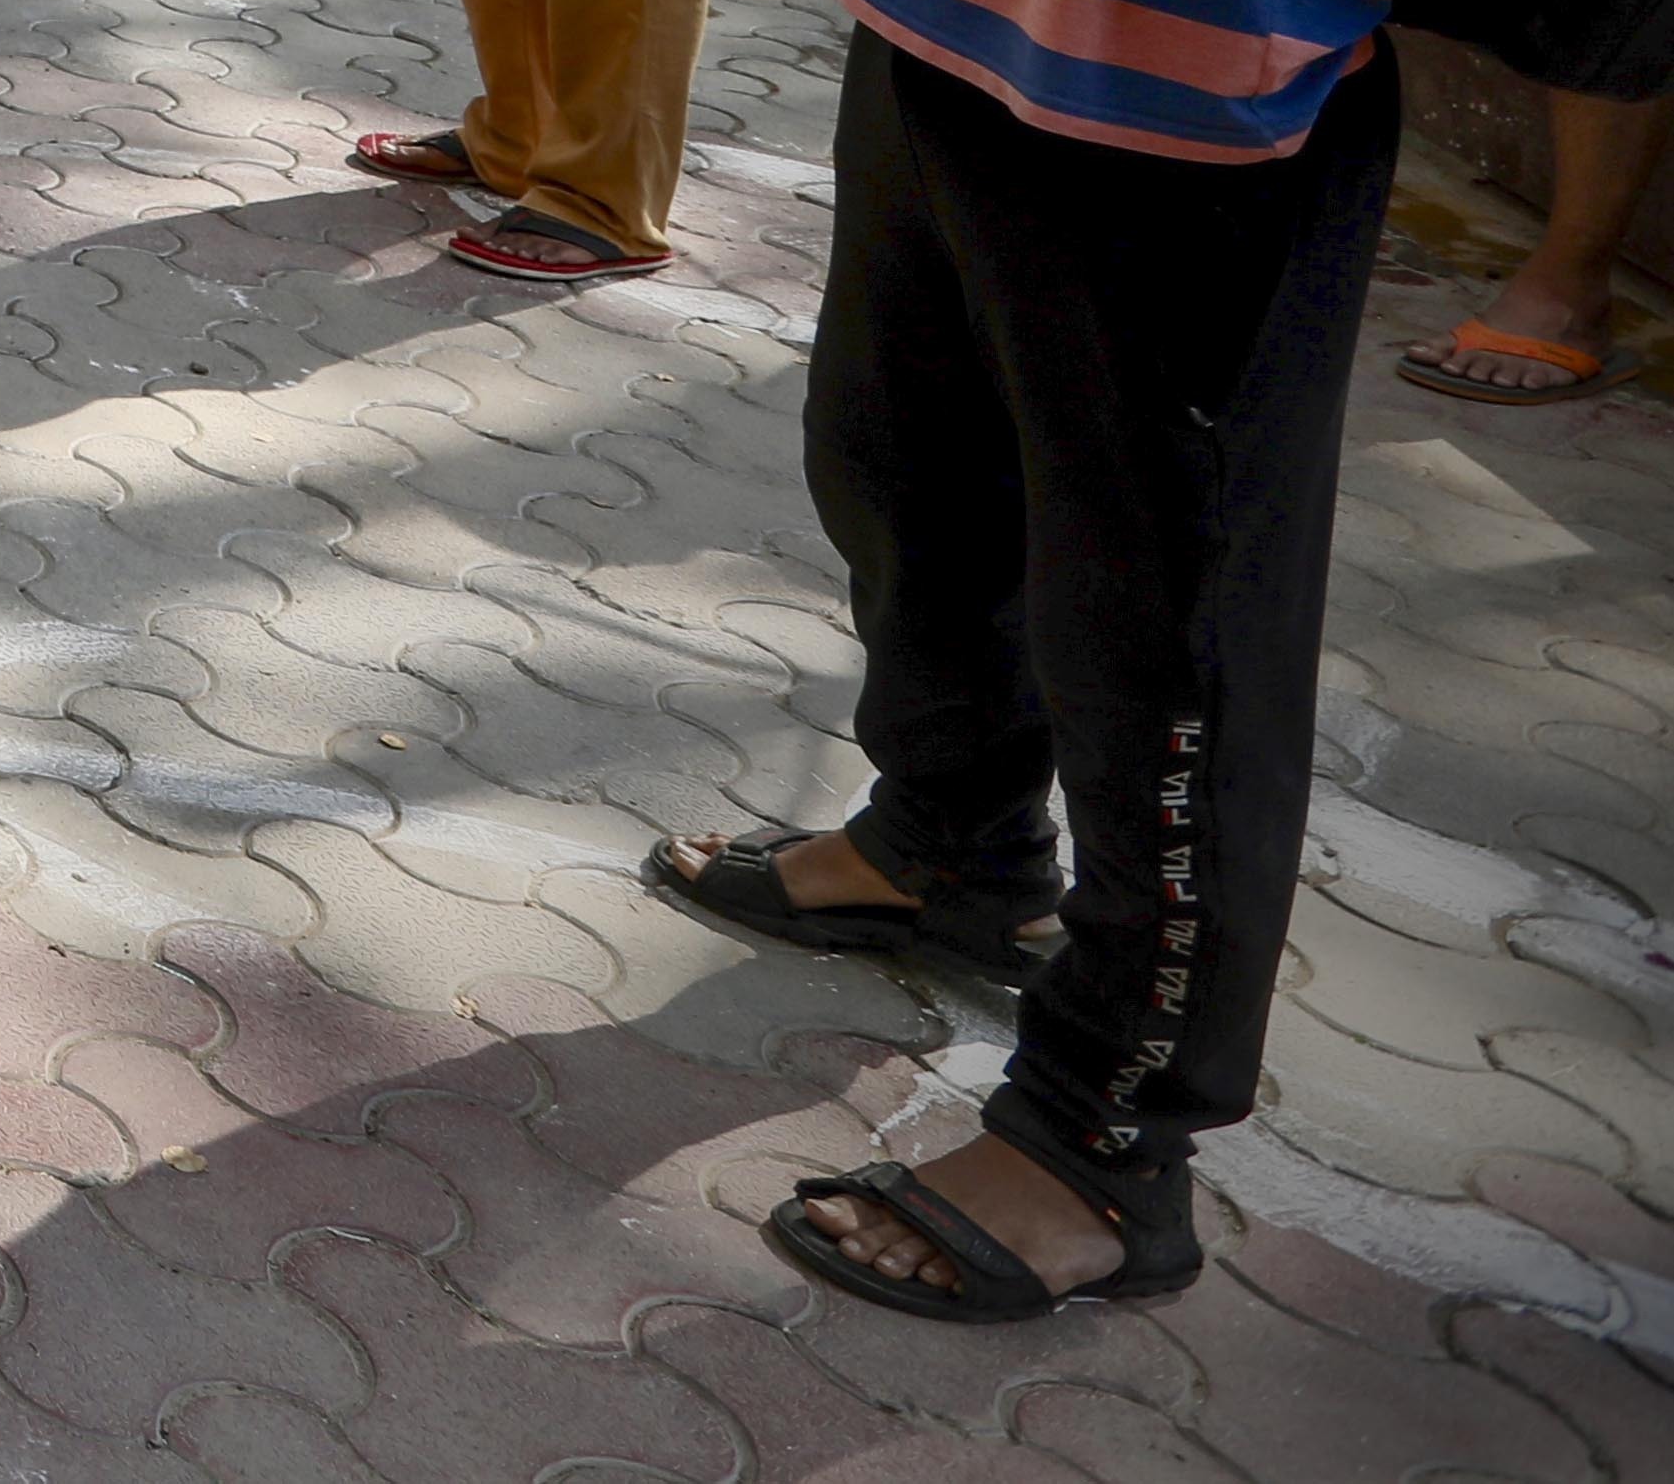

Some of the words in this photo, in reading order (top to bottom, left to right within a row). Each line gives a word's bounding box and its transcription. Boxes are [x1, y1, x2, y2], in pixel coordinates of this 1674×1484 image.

[1159, 770, 1193, 827] FILA
[1161, 844, 1198, 903] FILA
[1163, 919, 1198, 957] FILA
[1153, 966, 1189, 1015] FILA
